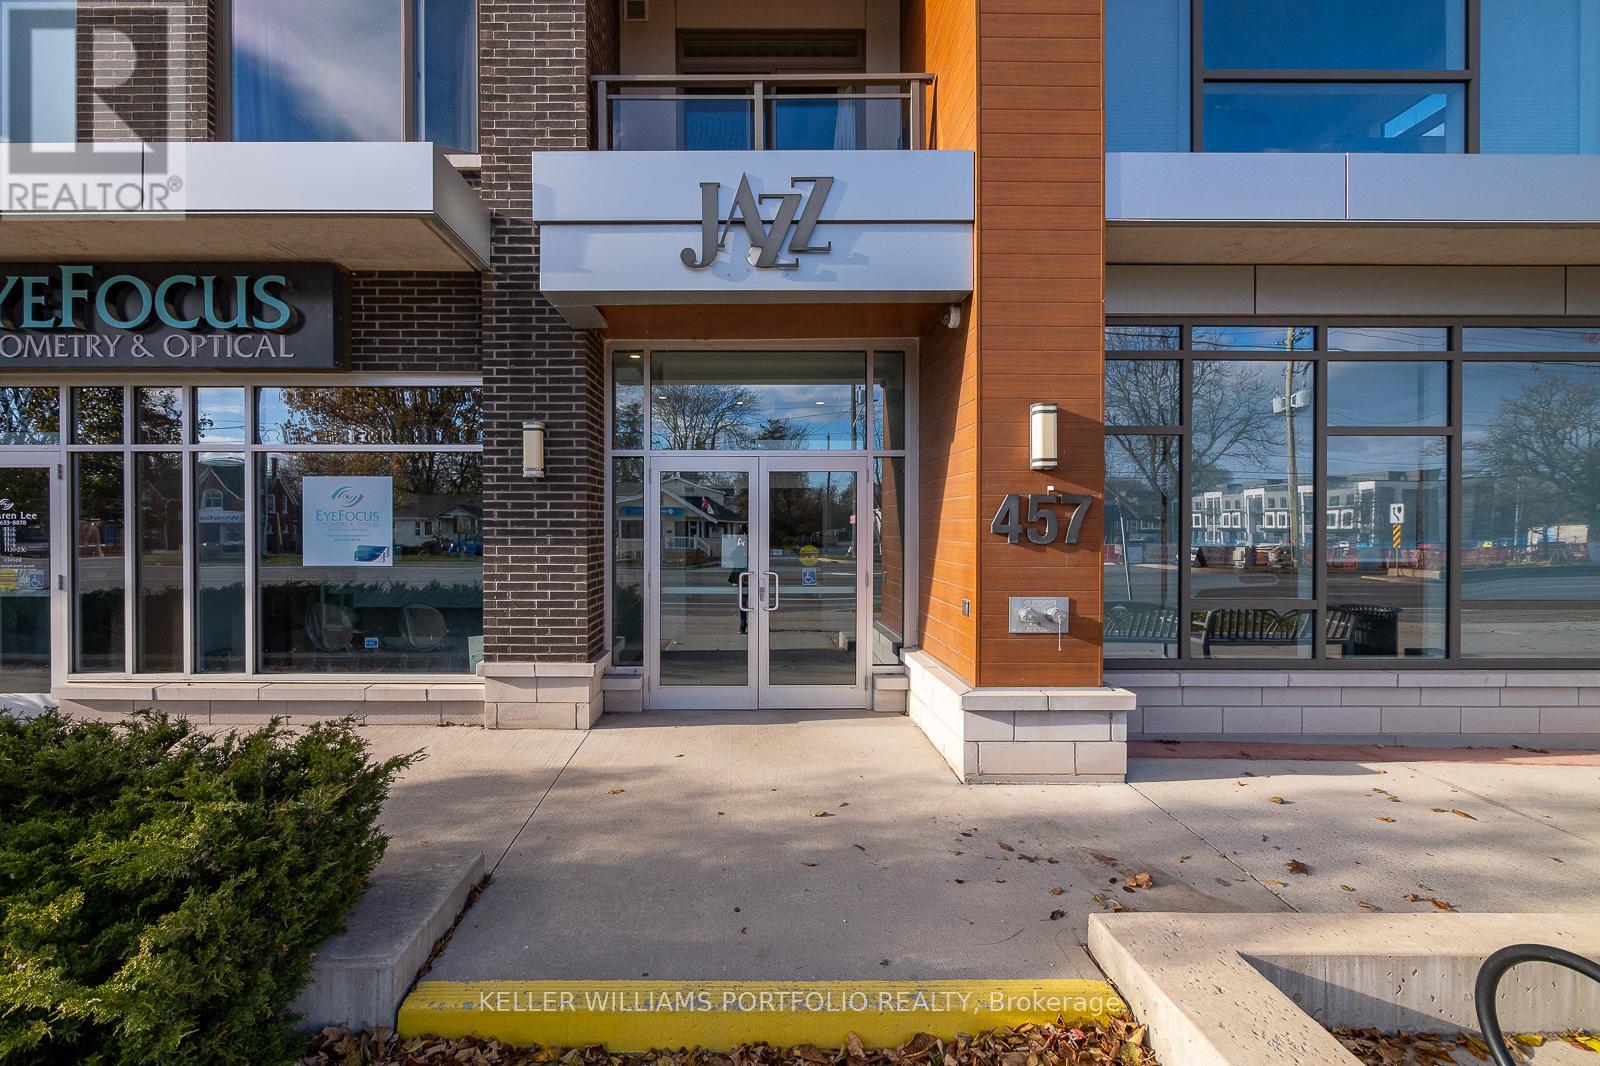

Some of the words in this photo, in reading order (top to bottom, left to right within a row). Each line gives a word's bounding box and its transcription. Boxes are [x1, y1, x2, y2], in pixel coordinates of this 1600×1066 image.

[680, 172, 834, 269] JAZZ
[131, 335, 155, 358] &
[163, 334, 295, 358] OPTICAL
[20, 511, 38, 520] Lee
[991, 494, 1093, 544] 457
